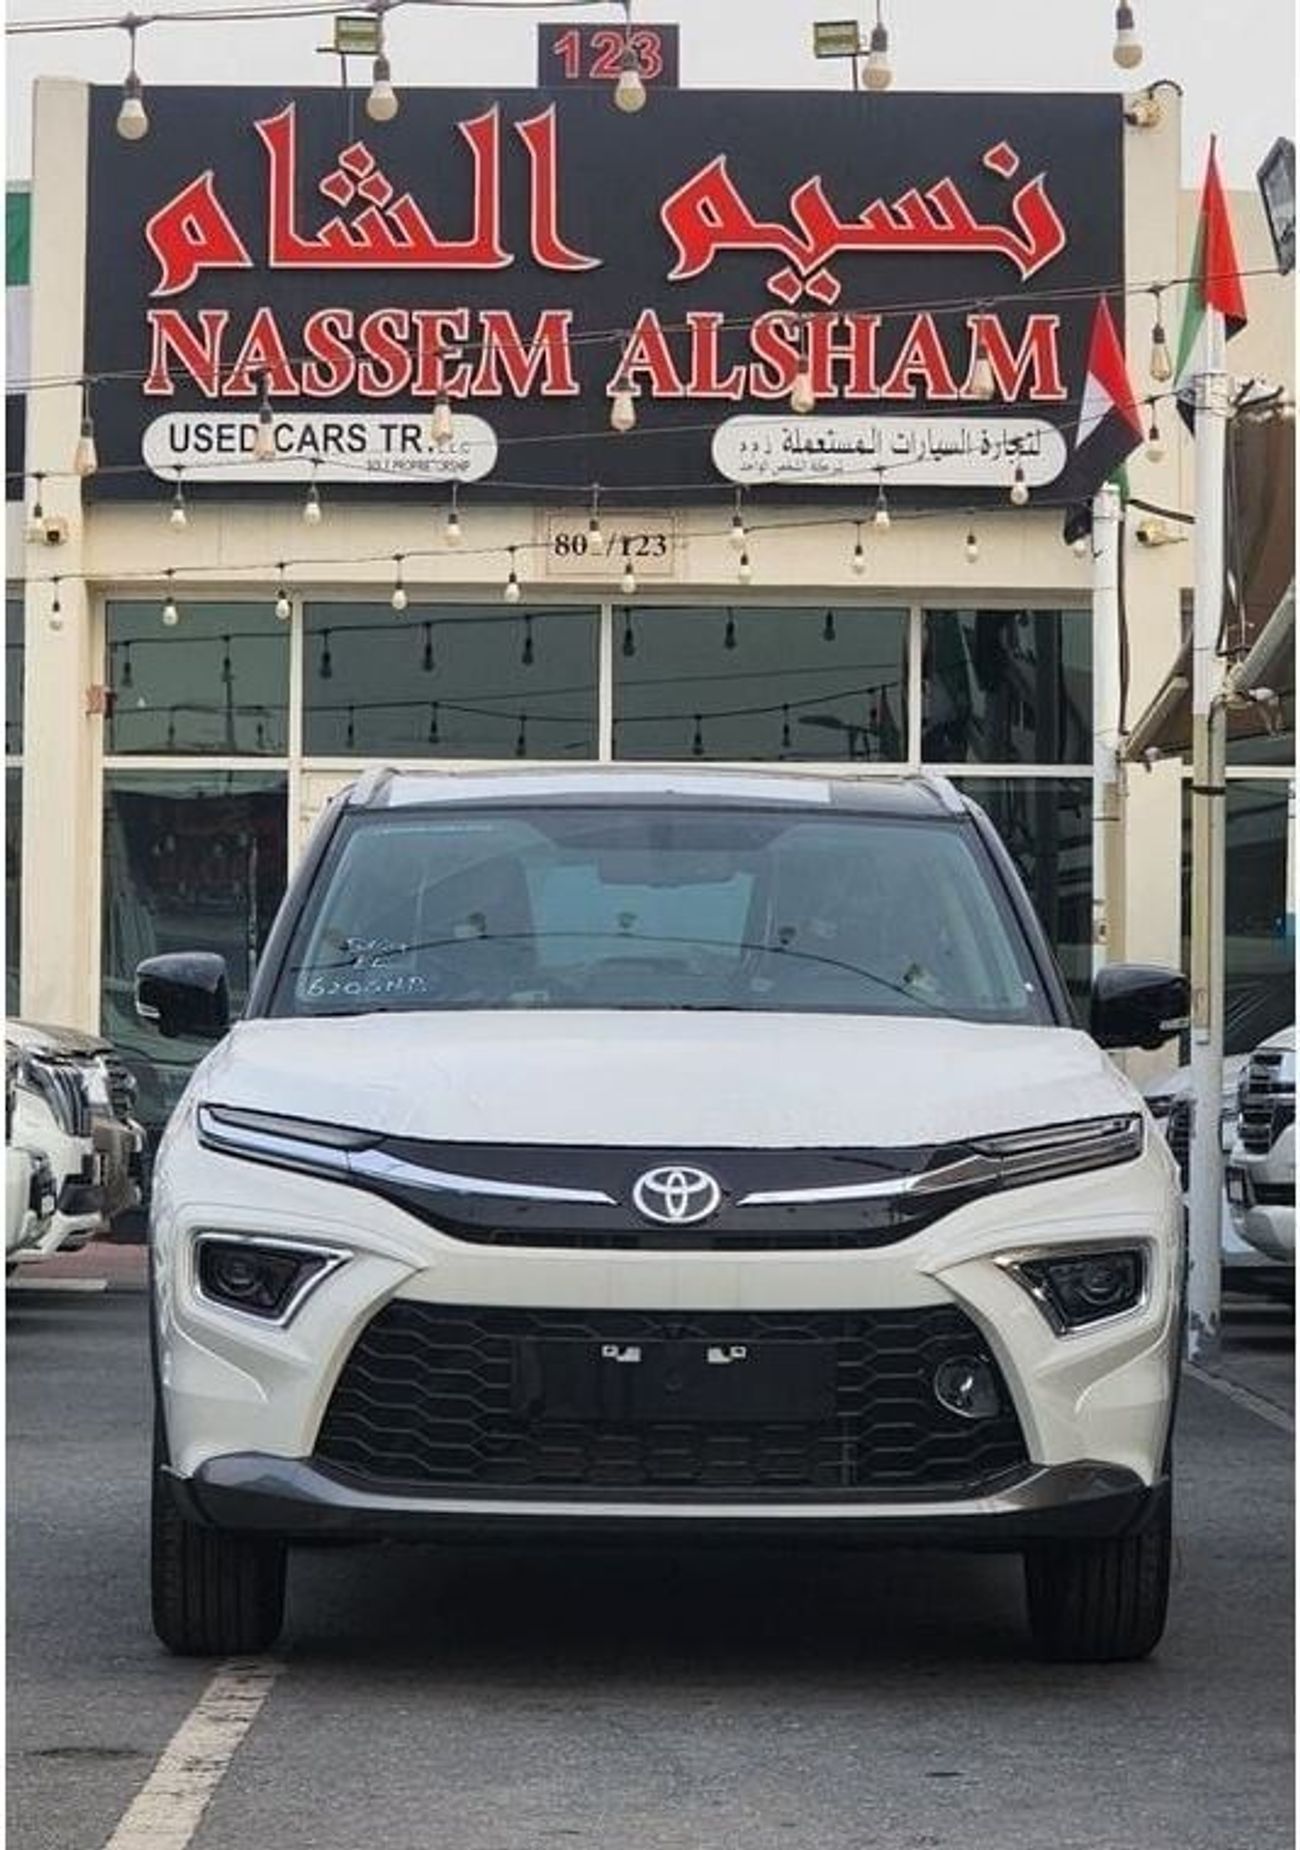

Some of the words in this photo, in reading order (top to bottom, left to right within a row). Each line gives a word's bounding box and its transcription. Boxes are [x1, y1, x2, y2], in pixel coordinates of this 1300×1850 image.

[554, 30, 662, 79] 123
[146, 103, 603, 298] الشام
[661, 141, 1066, 304] نسيم
[144, 306, 580, 398] NASSEM
[606, 308, 1068, 401] ALSHAM
[169, 423, 259, 452] USED
[274, 423, 367, 452] CARS
[782, 427, 883, 455] المستعملة
[892, 428, 971, 462] السيارات
[980, 428, 1041, 465] لتجارة
[555, 532, 667, 557] 80/123
